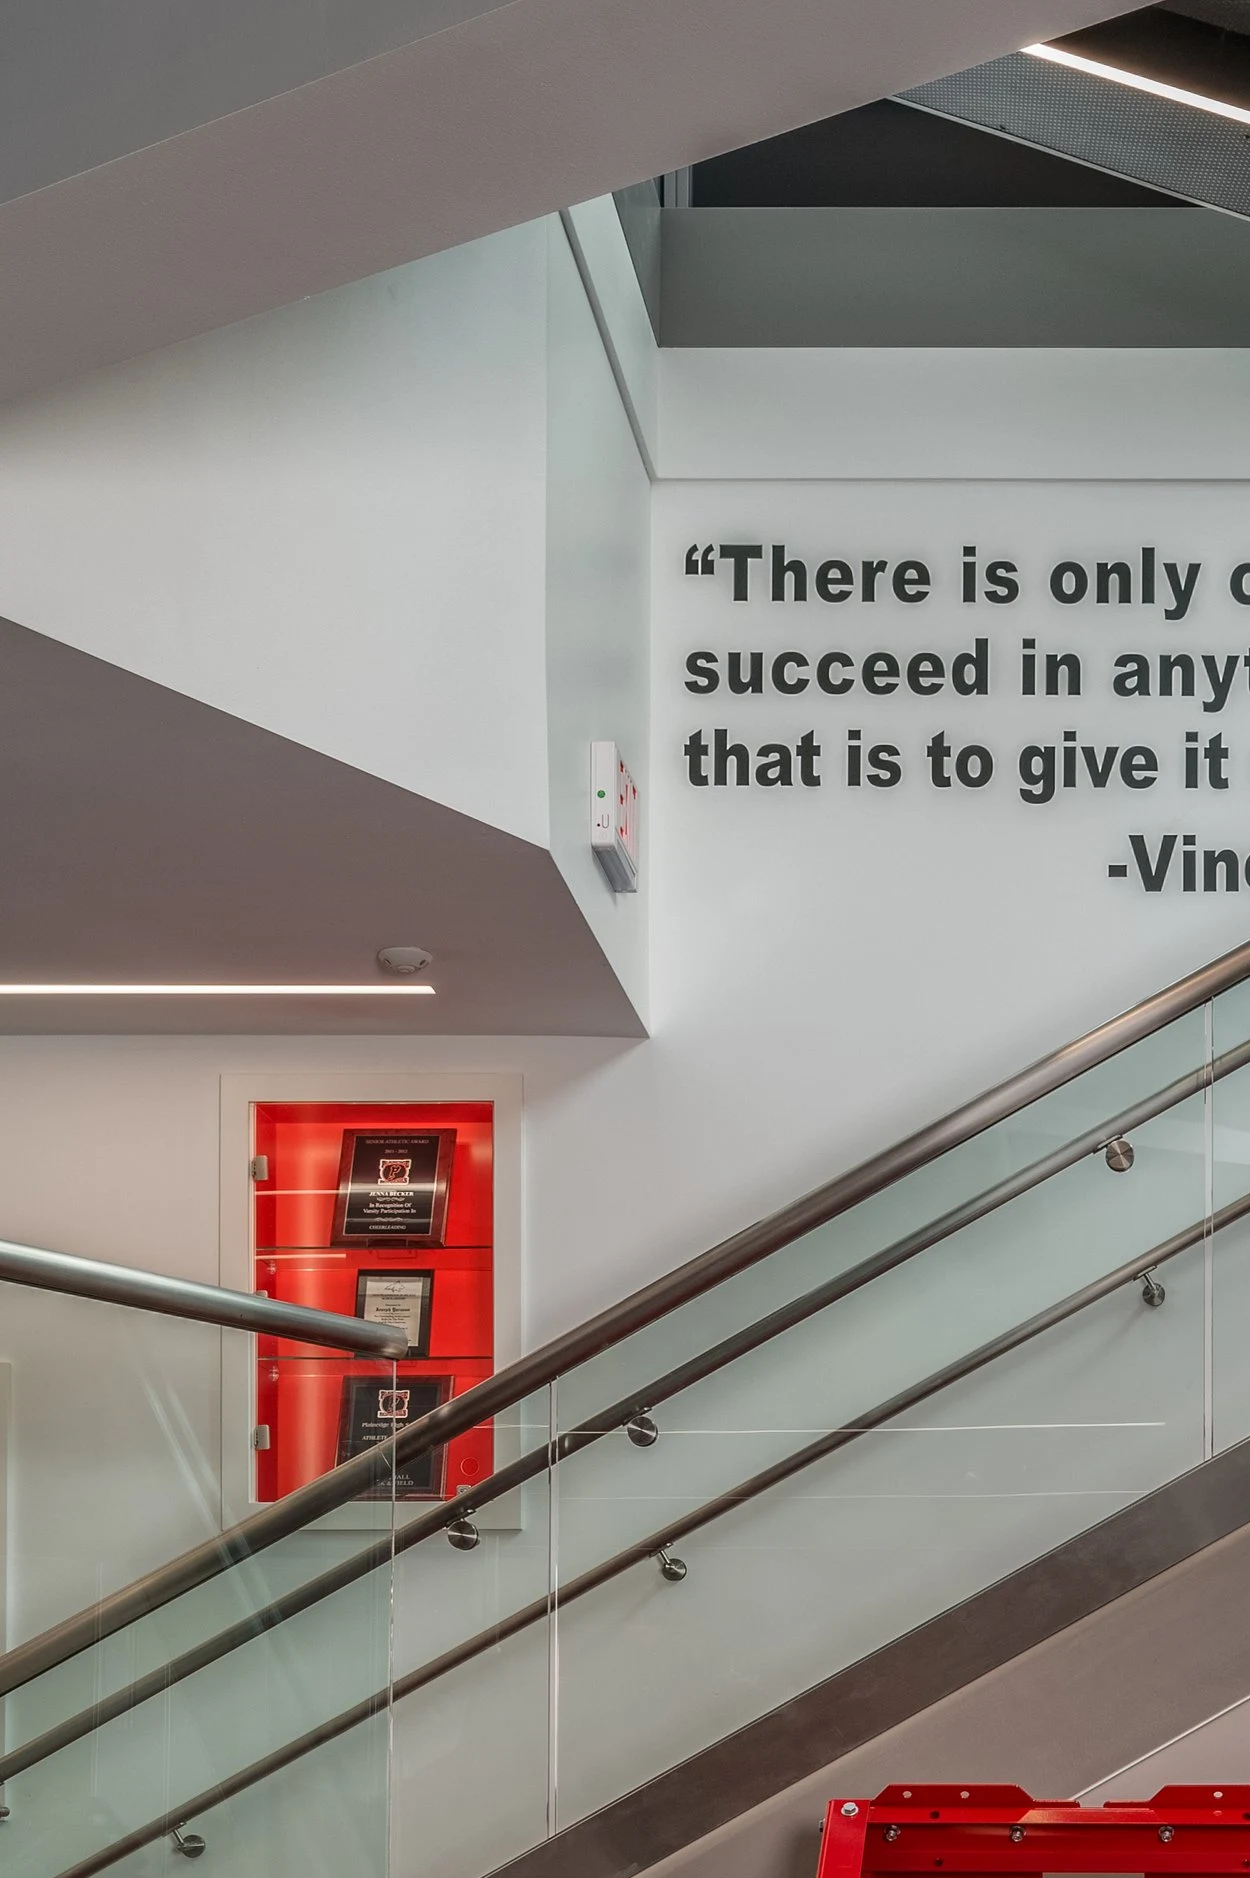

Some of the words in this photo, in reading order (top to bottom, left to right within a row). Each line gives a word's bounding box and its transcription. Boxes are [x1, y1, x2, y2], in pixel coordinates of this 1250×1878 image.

[684, 543, 931, 604] “There
[962, 545, 1020, 605] is
[1049, 546, 1202, 621] only
[684, 637, 989, 696] succeed
[1021, 637, 1081, 696] in
[683, 728, 821, 788] that
[847, 729, 902, 788] is
[926, 730, 994, 788] to
[1018, 730, 1159, 805] give
[1184, 731, 1229, 790] it
